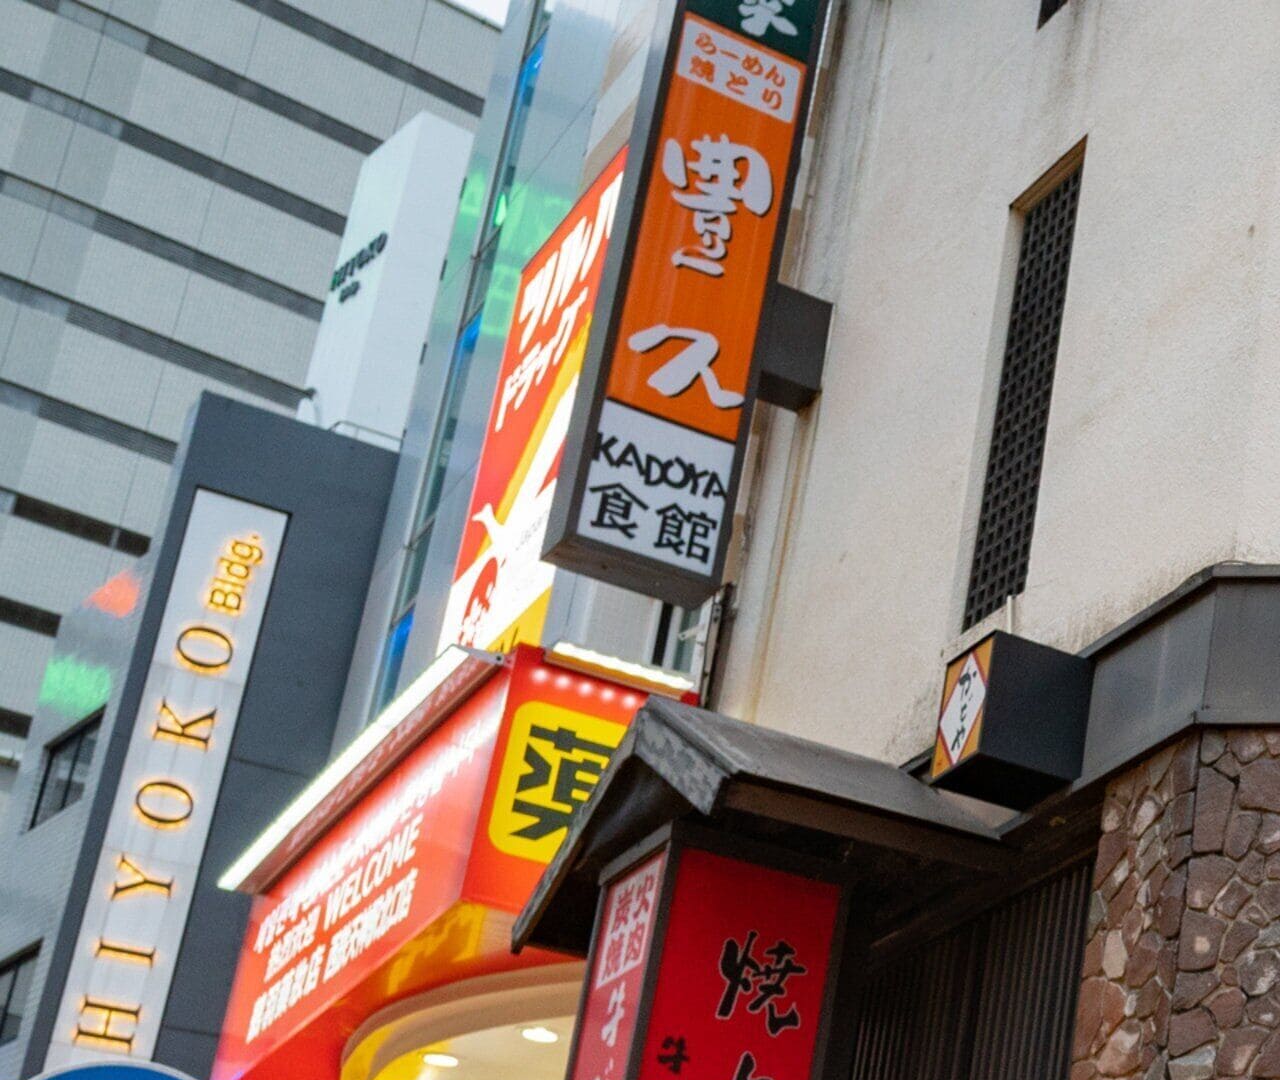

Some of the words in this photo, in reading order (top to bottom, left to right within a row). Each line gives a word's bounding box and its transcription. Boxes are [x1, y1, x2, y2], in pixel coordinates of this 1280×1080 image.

[690, 55, 783, 111] 焼とり
[694, 32, 786, 88] らーめん
[591, 432, 729, 499] KADOYA
[589, 481, 717, 564] 食館
[73, 625, 234, 1053] HIYOKO
[208, 533, 264, 614] Bldg.
[322, 813, 424, 931] WELCOME
